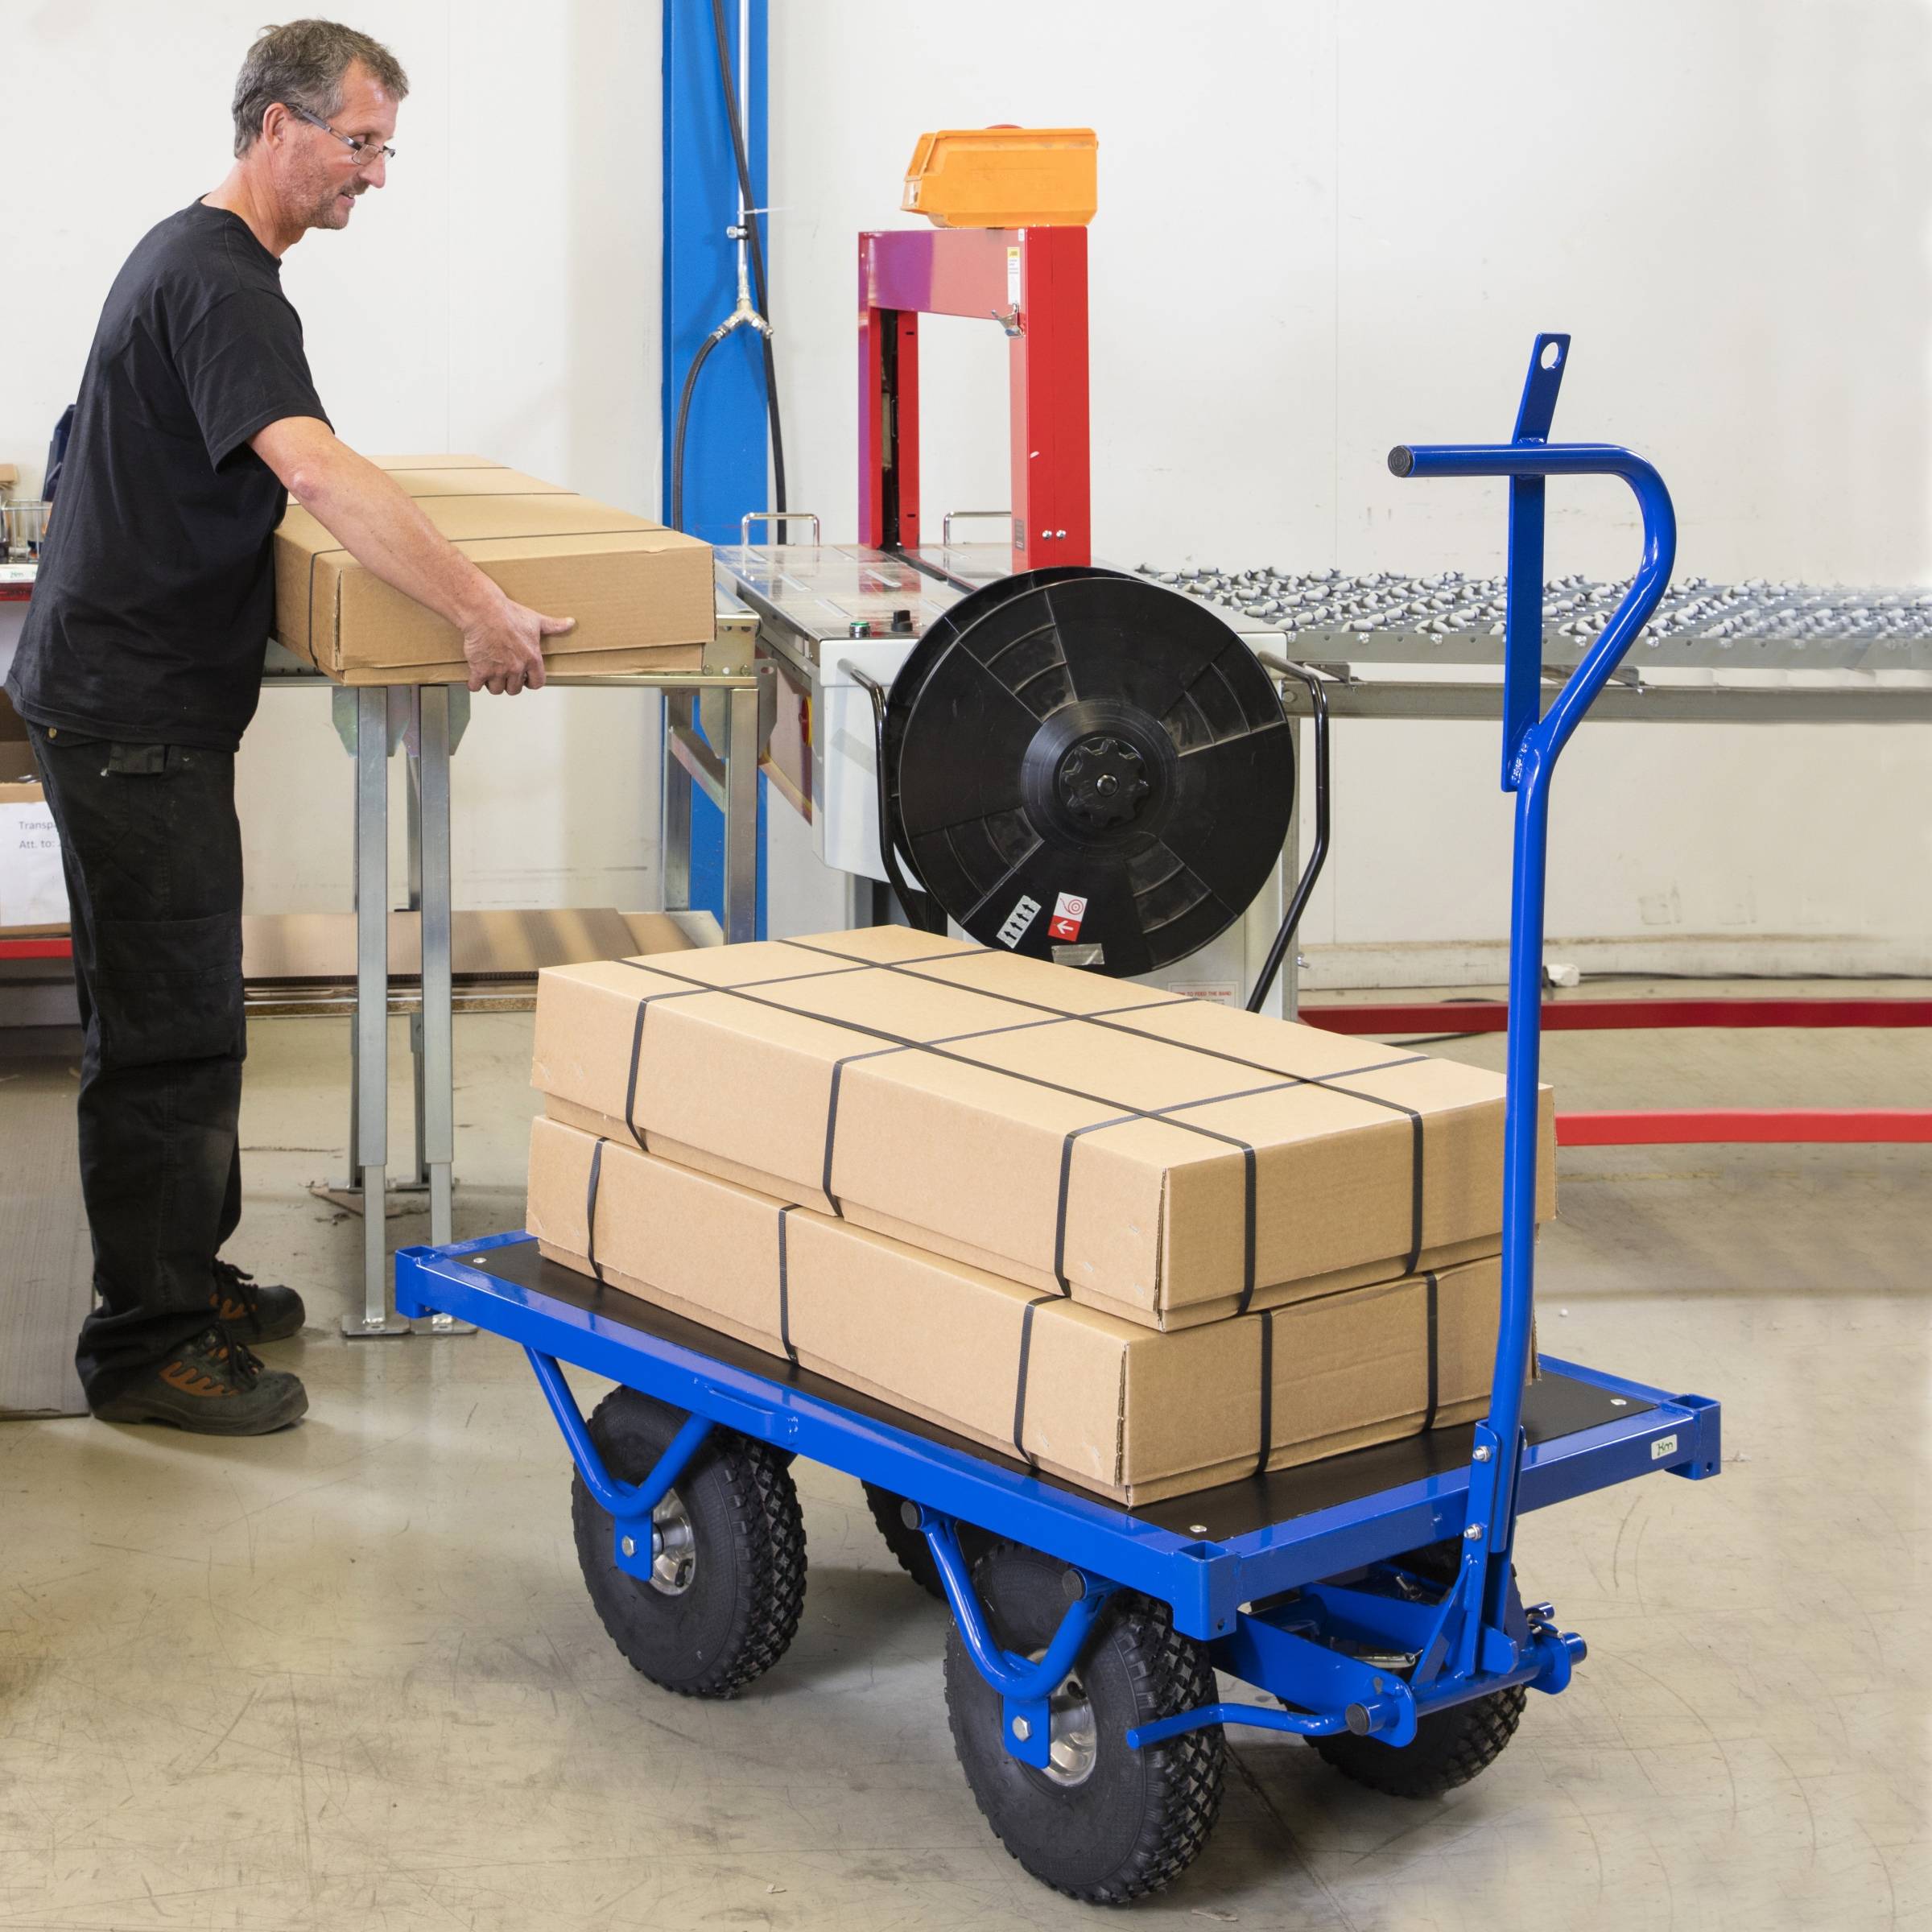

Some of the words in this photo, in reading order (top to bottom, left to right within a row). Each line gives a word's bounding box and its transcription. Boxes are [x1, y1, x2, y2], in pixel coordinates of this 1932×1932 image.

[19, 821, 56, 831] Transp
[19, 840, 37, 848] Att.
[41, 840, 56, 848] to:
